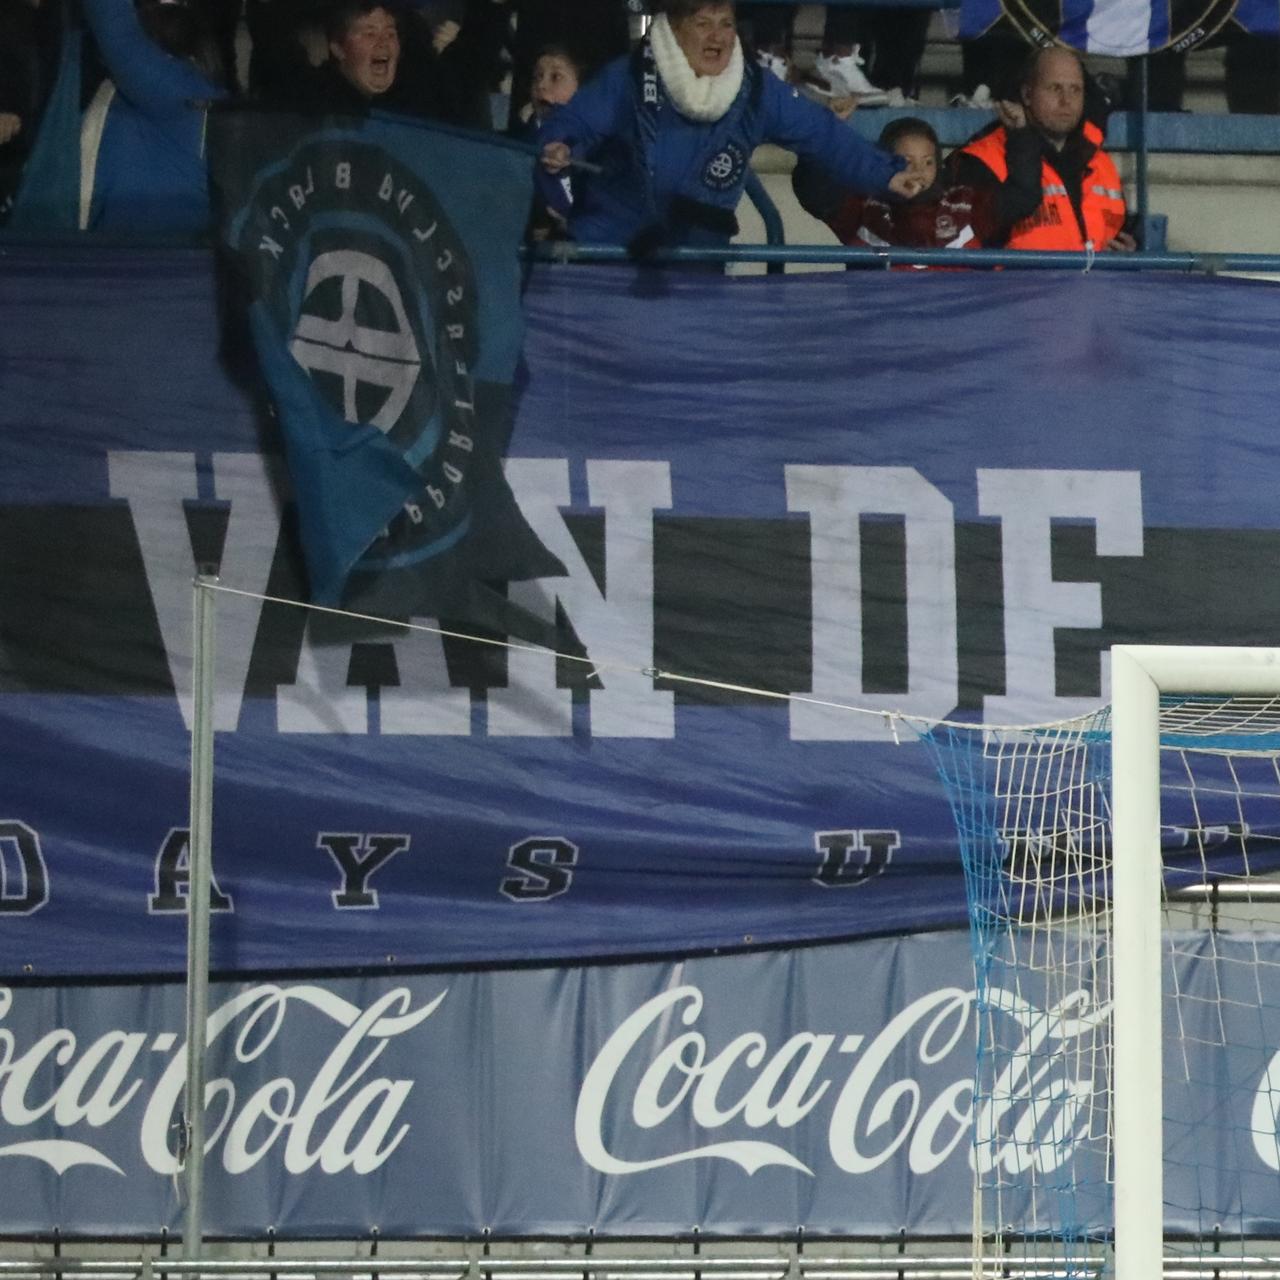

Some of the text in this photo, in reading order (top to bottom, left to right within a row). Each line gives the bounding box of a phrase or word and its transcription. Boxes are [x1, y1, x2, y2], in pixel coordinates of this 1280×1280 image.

[1173, 27, 1206, 52] 2023
[784, 464, 1144, 745] DE
[0, 984, 449, 1176] ca-Cola
[574, 986, 1113, 1176] Coca-Cola
